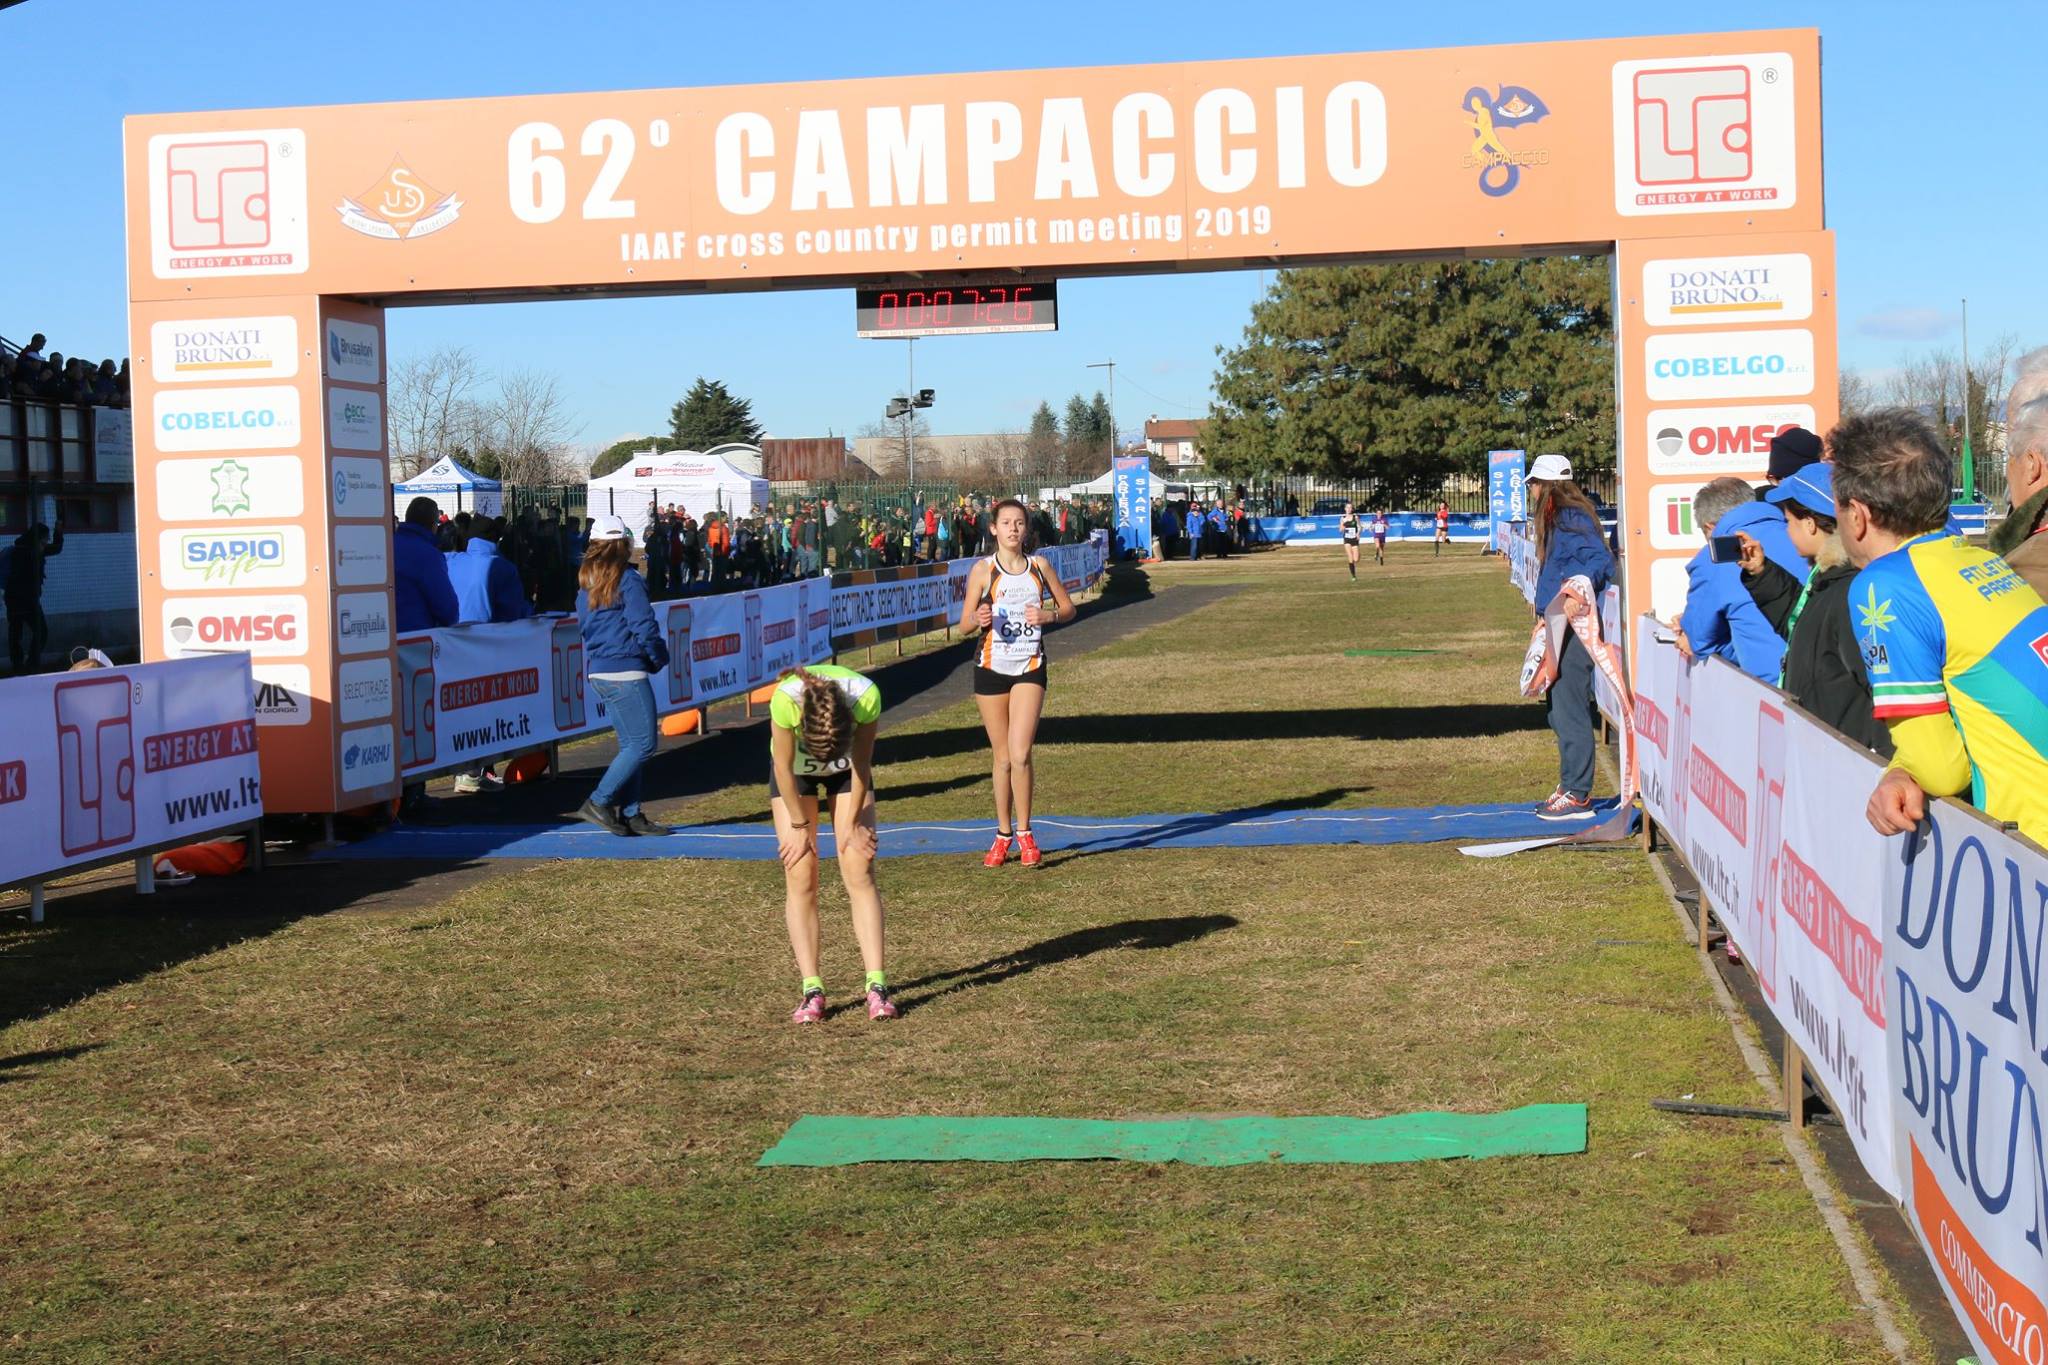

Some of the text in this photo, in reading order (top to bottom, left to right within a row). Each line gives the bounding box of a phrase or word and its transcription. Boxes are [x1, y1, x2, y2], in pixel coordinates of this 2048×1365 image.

[715, 81, 1387, 215] CAMPACCIO
[1462, 150, 1549, 169] CAMPACCIO
[1638, 189, 1773, 205] ENERGY AT WORK
[621, 205, 1272, 261] IAAF cross country permit meeting 2019
[172, 256, 289, 268] ENERGY AT WORK
[1670, 268, 1770, 288] DONATI
[1671, 287, 1759, 305] BRUNO
[175, 329, 261, 347] DONATI
[176, 347, 251, 363] BRUNO
[1654, 355, 1784, 378] COBELGO
[162, 409, 274, 431] COBELGO
[1688, 423, 1801, 456] OMS
[1135, 478, 1147, 523] START
[1493, 471, 1505, 517] START
[188, 540, 279, 562] SAPIO
[198, 614, 296, 643] OMSG
[1000, 622, 1033, 637] 638
[442, 672, 536, 710] ENERGY AT WORK
[146, 724, 252, 769] ENERGY AT
[453, 713, 531, 752] www.ltc.it
[361, 743, 391, 766] KARHU
[1692, 838, 1740, 924] www.ltc.it
[1782, 859, 1886, 1017] ENERGY AT WORK
[1896, 814, 2048, 1067] DON
[1940, 1219, 2045, 1365] COMMERCIO
